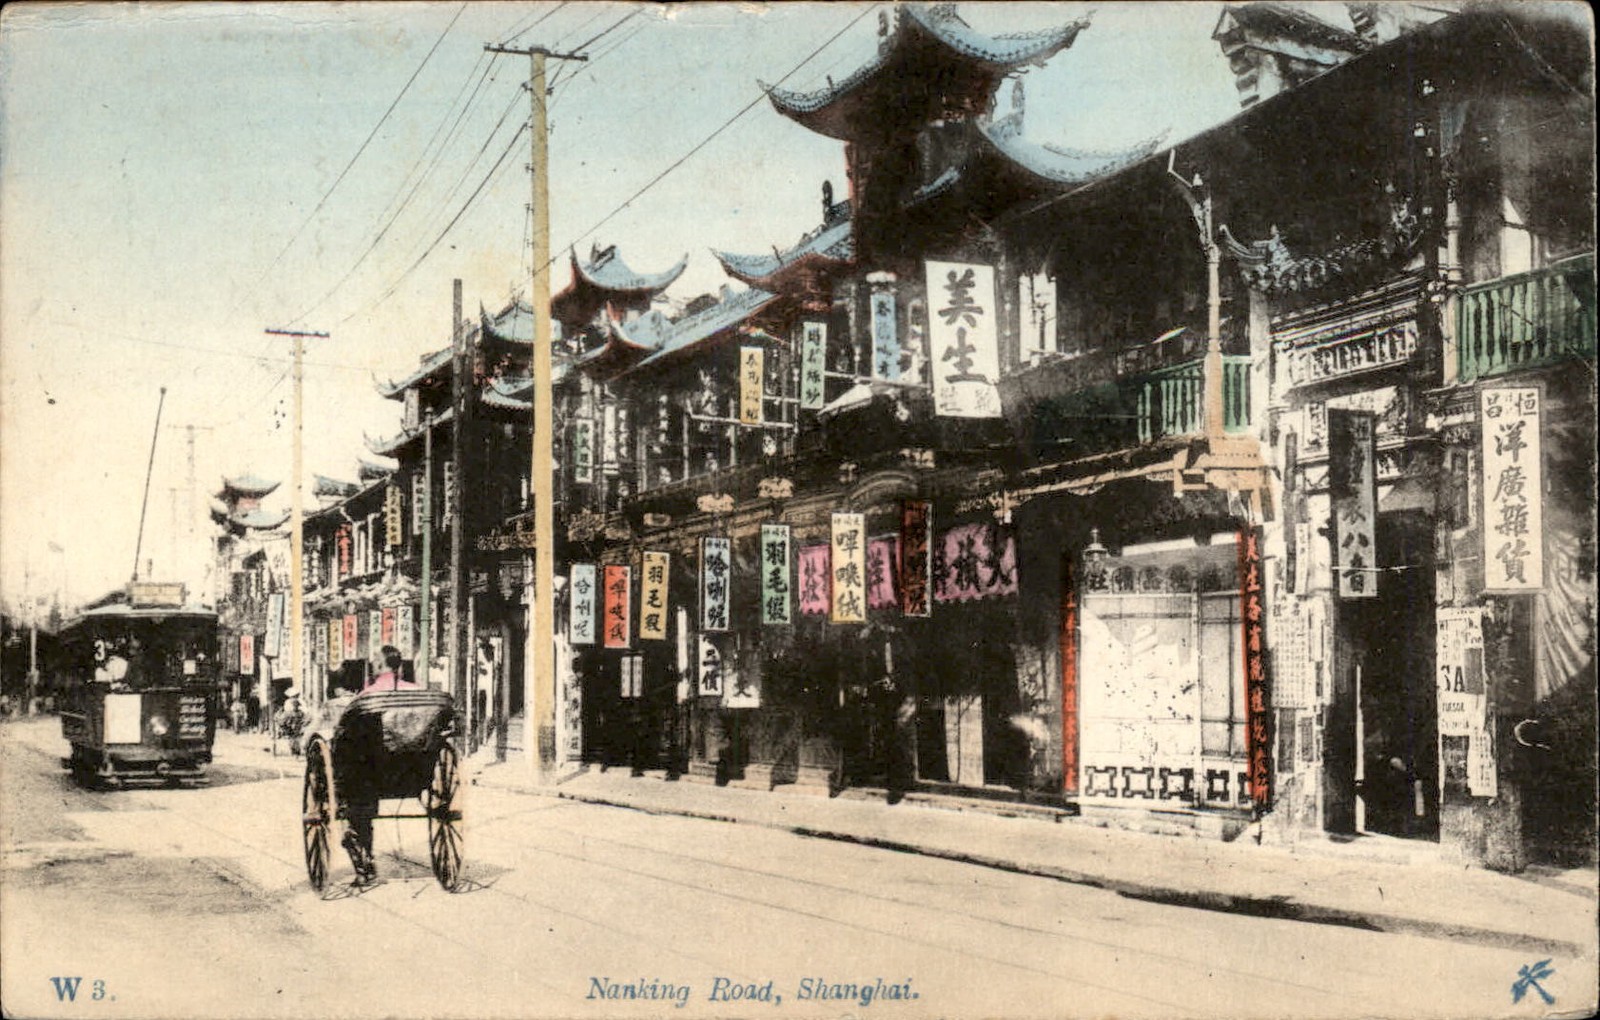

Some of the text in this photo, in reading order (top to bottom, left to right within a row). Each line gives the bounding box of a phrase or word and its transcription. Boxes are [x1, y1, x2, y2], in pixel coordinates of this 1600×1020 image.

[938, 268, 989, 384] 美生
[1491, 419, 1532, 583] 洋廣雜貨
